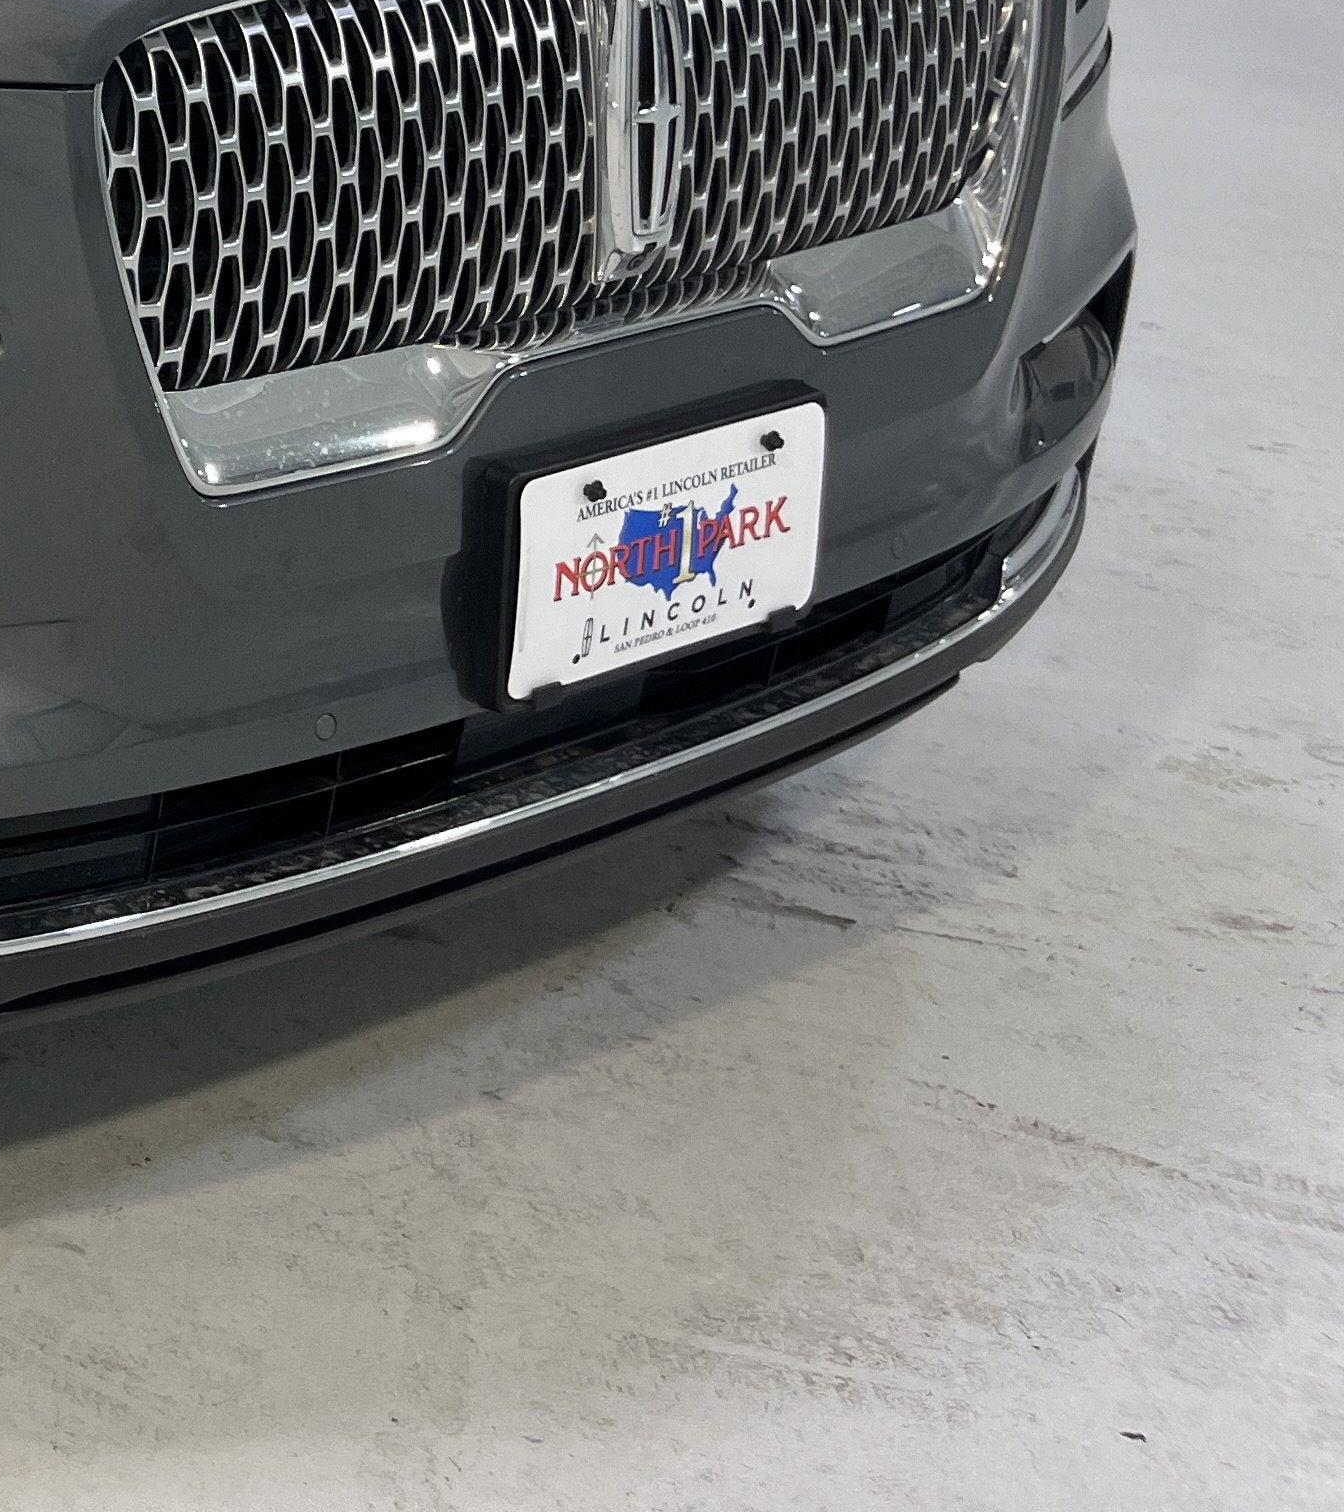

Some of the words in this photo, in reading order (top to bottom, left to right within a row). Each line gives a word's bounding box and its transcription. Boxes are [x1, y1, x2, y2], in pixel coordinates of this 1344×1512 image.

[576, 490, 644, 522] AMERICA'S
[646, 487, 658, 501] #1
[661, 468, 718, 498] LINCOLN
[720, 452, 777, 481] RETAILER
[553, 528, 678, 602] NORTH
[697, 495, 791, 558] PARK
[599, 578, 754, 644] LINCOLN
[613, 640, 633, 654] SAN
[634, 629, 664, 648] PEDRO
[675, 618, 701, 635] LOOP
